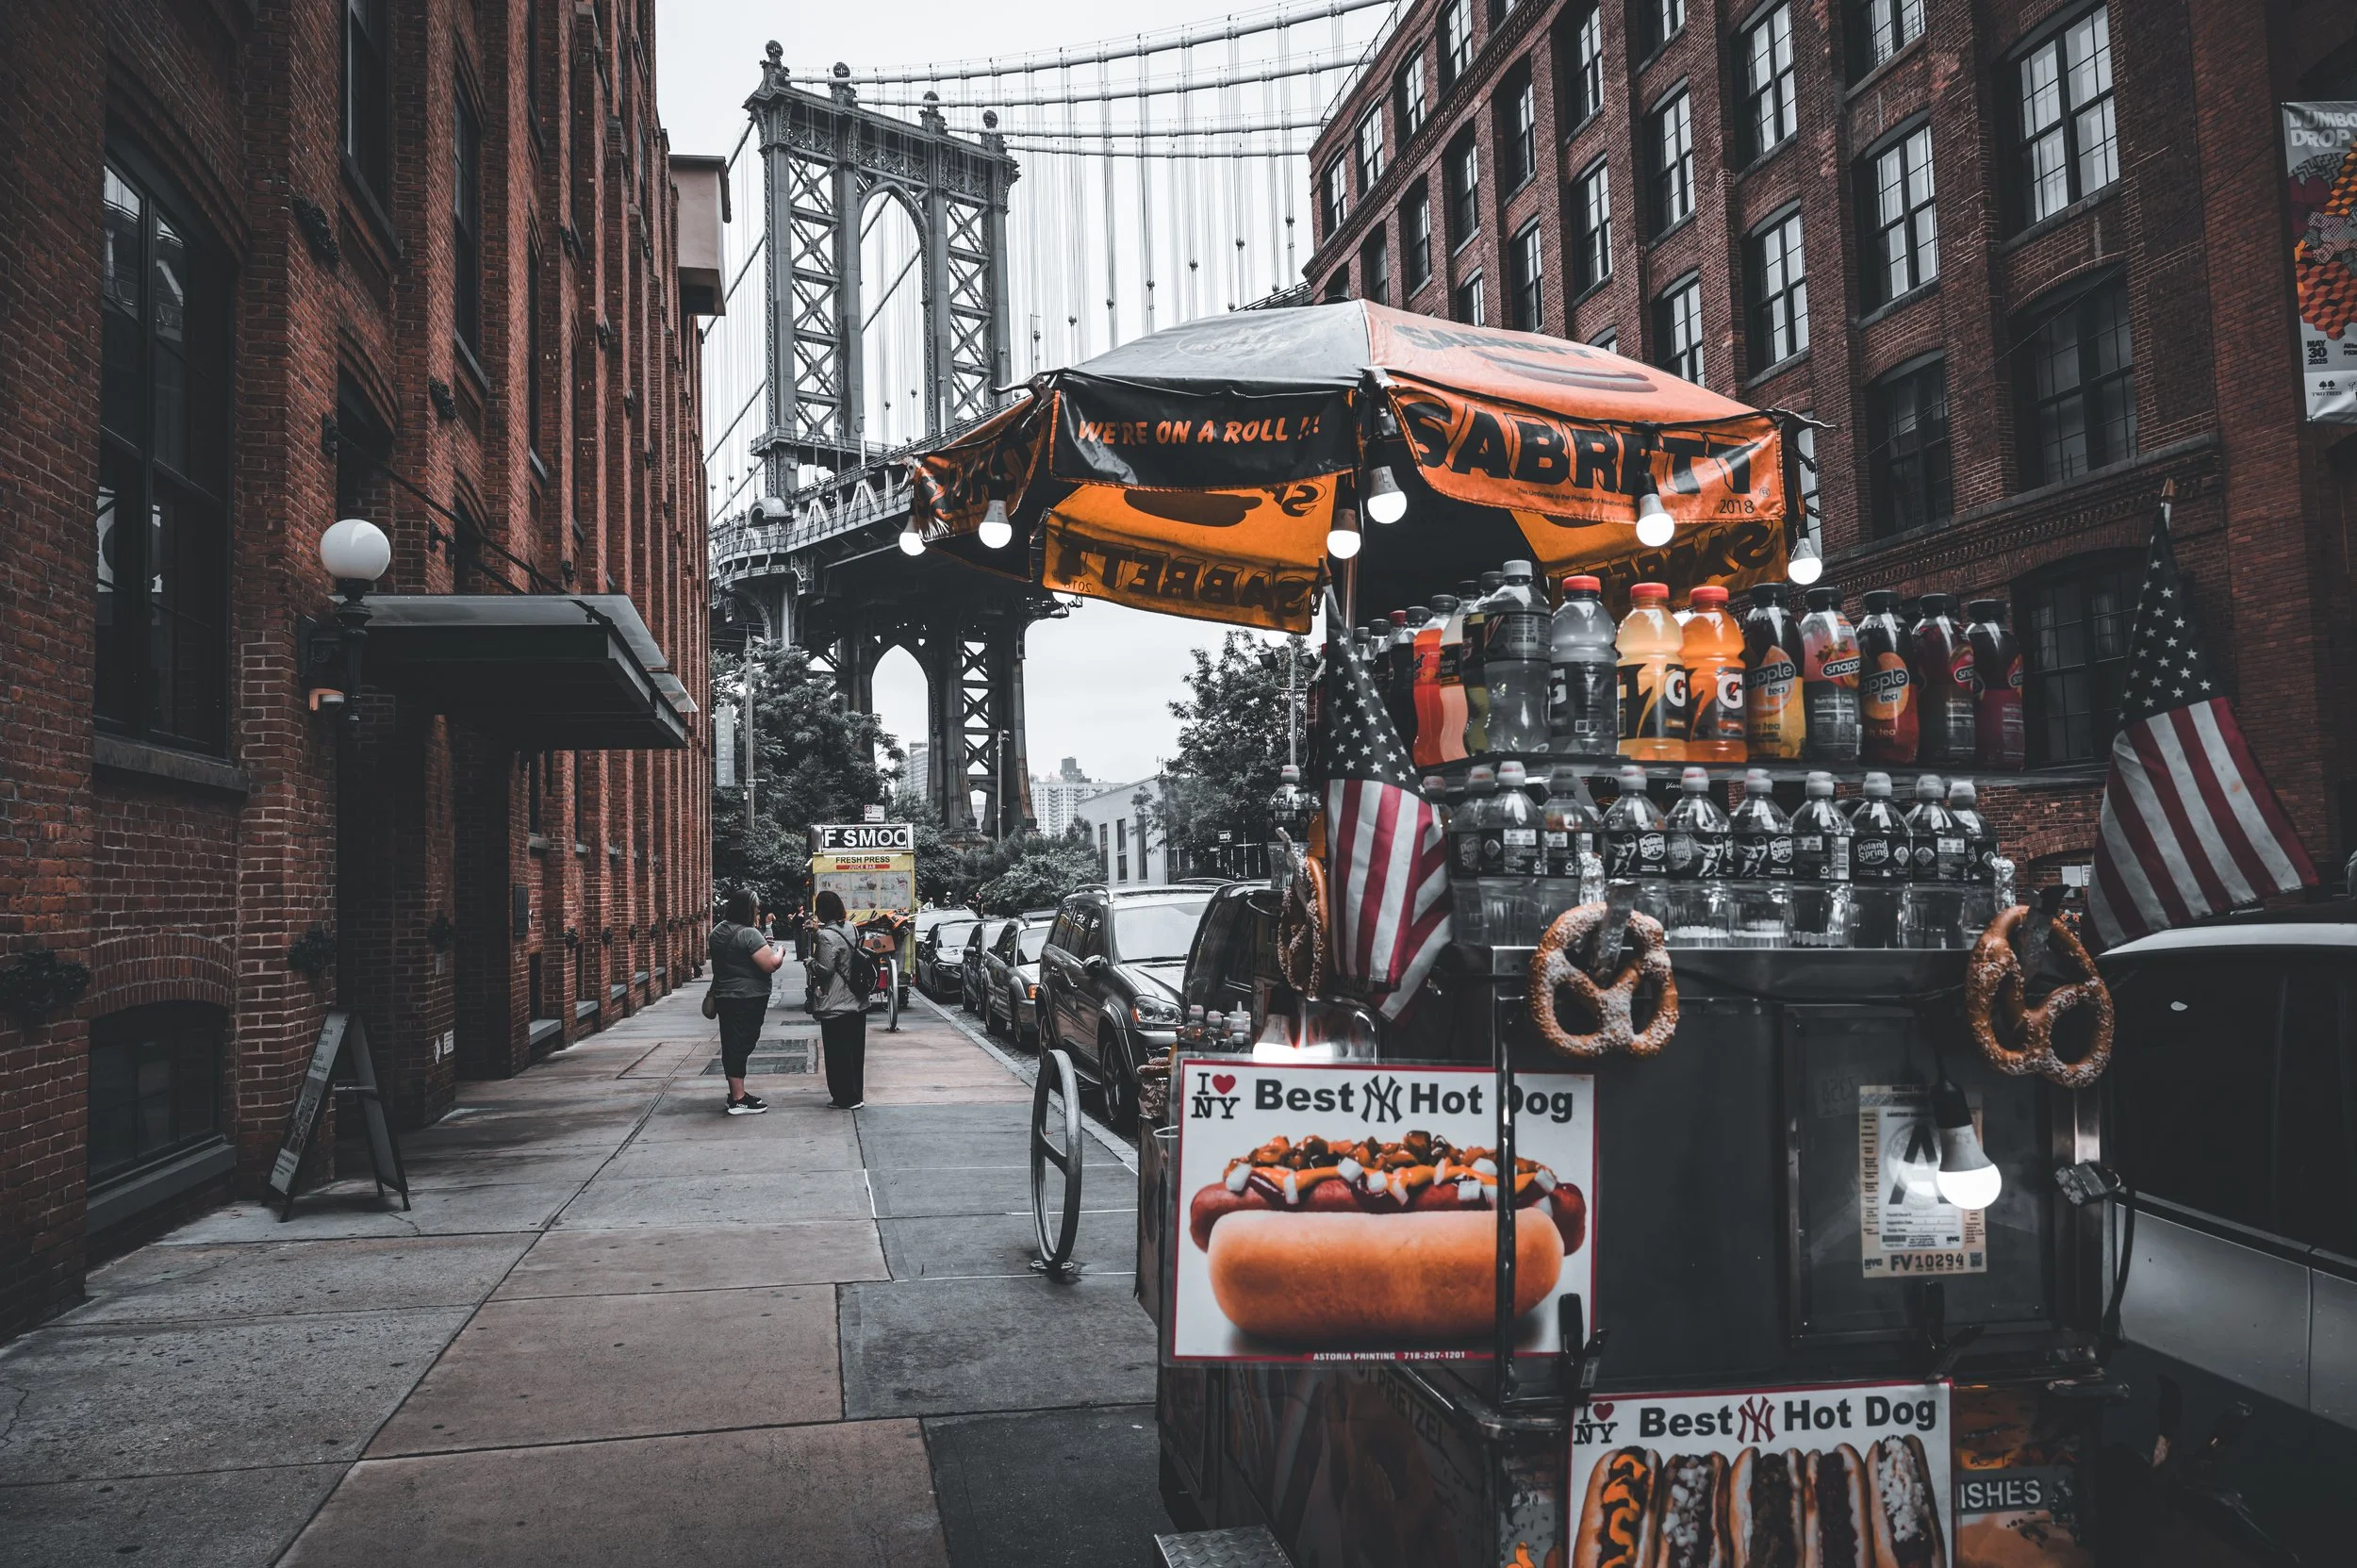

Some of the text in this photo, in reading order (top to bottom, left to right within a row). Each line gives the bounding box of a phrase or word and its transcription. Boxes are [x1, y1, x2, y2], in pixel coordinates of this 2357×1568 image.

[2291, 129, 2350, 147] DROP
[2308, 347, 2328, 357] 30
[1078, 421, 1148, 446] WE'RE
[1156, 421, 1192, 444] ON
[1197, 420, 1218, 443] A
[1224, 417, 1290, 442] ROLL
[1394, 390, 1763, 494] SABRETT
[1719, 499, 1754, 515] 2018
[1717, 672, 1743, 709] G
[1768, 685, 1785, 696] tea
[1880, 693, 1898, 702] tea
[1857, 839, 1887, 851] Poland
[1858, 848, 1889, 862] Spring
[1196, 1073, 1211, 1095] I
[1255, 1079, 1355, 1113] Best
[1410, 1082, 1483, 1114] Hot
[1191, 1097, 1241, 1119] NY
[1313, 1350, 1465, 1361] ASTORIA PRINTING 718-267-1201
[1579, 1403, 1592, 1424] I
[1640, 1404, 1734, 1437] Best
[1784, 1398, 1852, 1431] Hot
[1866, 1395, 1936, 1431] Dog
[1573, 1422, 1619, 1444] NY
[1960, 1478, 2042, 1510] ISHES
